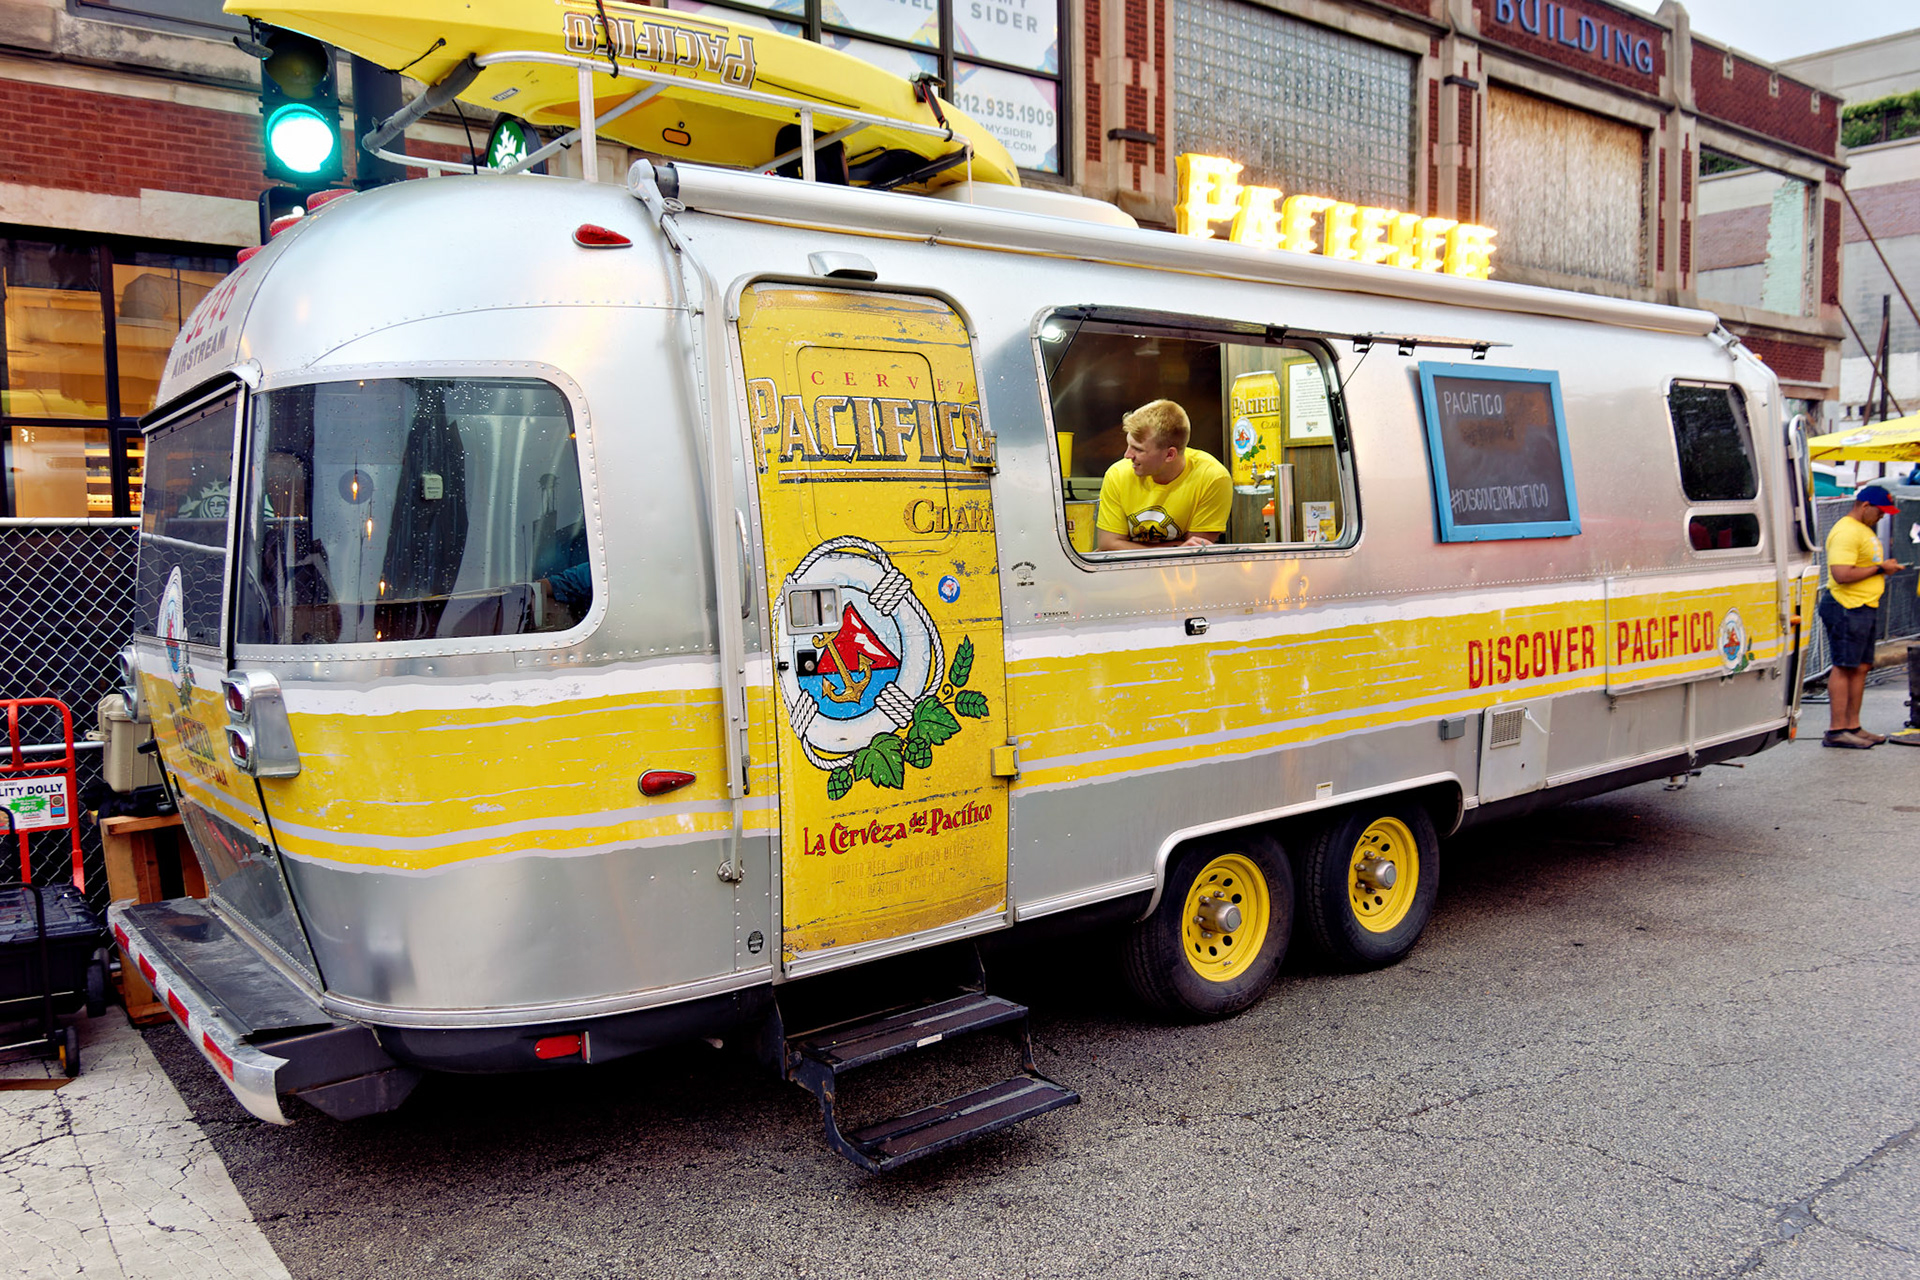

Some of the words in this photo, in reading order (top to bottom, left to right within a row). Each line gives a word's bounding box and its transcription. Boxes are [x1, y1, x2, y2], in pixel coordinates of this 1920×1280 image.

[970, 3, 1038, 34] SIDER
[1495, 0, 1653, 74] BUILDING
[563, 11, 757, 90] PACIFICO
[953, 91, 1055, 128] 312.935.1909
[171, 325, 229, 380] AIRSTREAM
[810, 370, 978, 398] CERVEZA
[1443, 391, 1503, 416] PACIFICO
[747, 377, 994, 475] PACIFICO
[903, 498, 995, 534] CLARA
[1450, 483, 1549, 514] #DISCOVERPACIFICO
[1468, 625, 1595, 690] DISCOVER
[1617, 611, 1715, 666] PACIFICO
[27, 783, 63, 795] DOLLY
[803, 827, 827, 857] La
[829, 819, 908, 855] Cerveza
[909, 811, 928, 833] del
